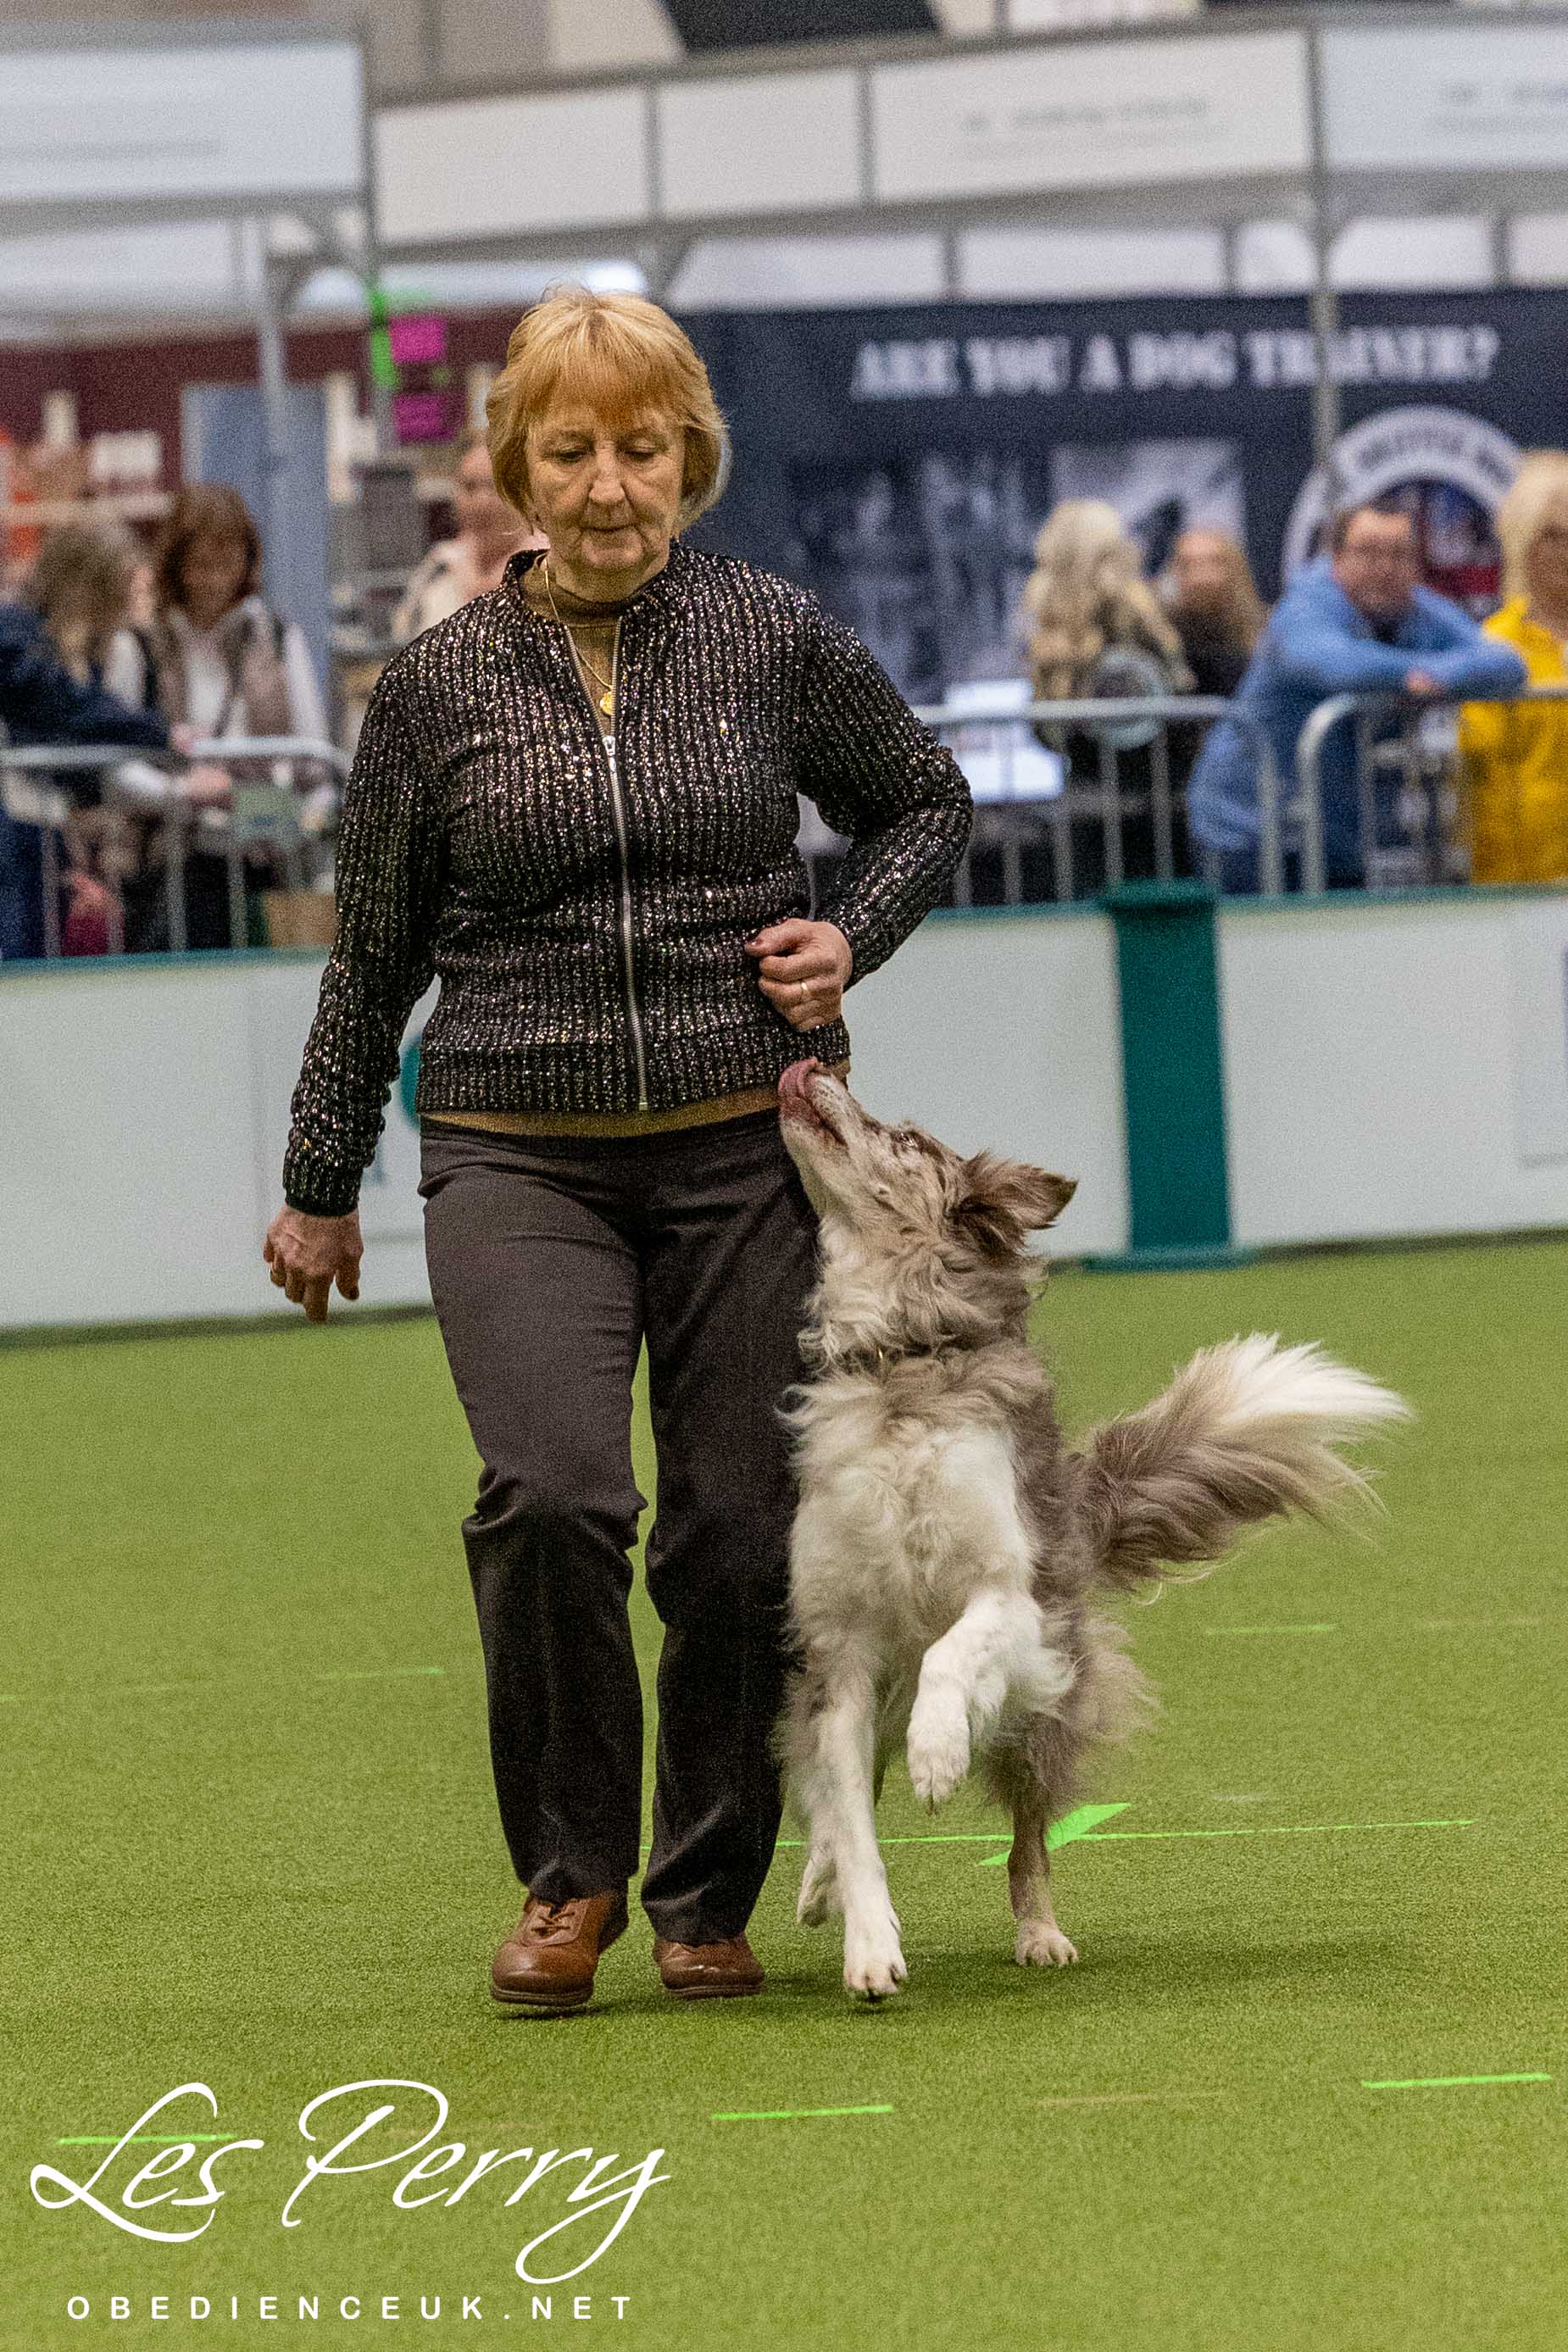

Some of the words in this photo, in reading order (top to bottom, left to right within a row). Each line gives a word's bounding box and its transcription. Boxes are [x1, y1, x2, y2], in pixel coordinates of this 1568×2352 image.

[852, 339, 957, 398] ARE
[969, 338, 1067, 392] YOU
[1081, 336, 1120, 391] A
[1131, 331, 1236, 389] DOG
